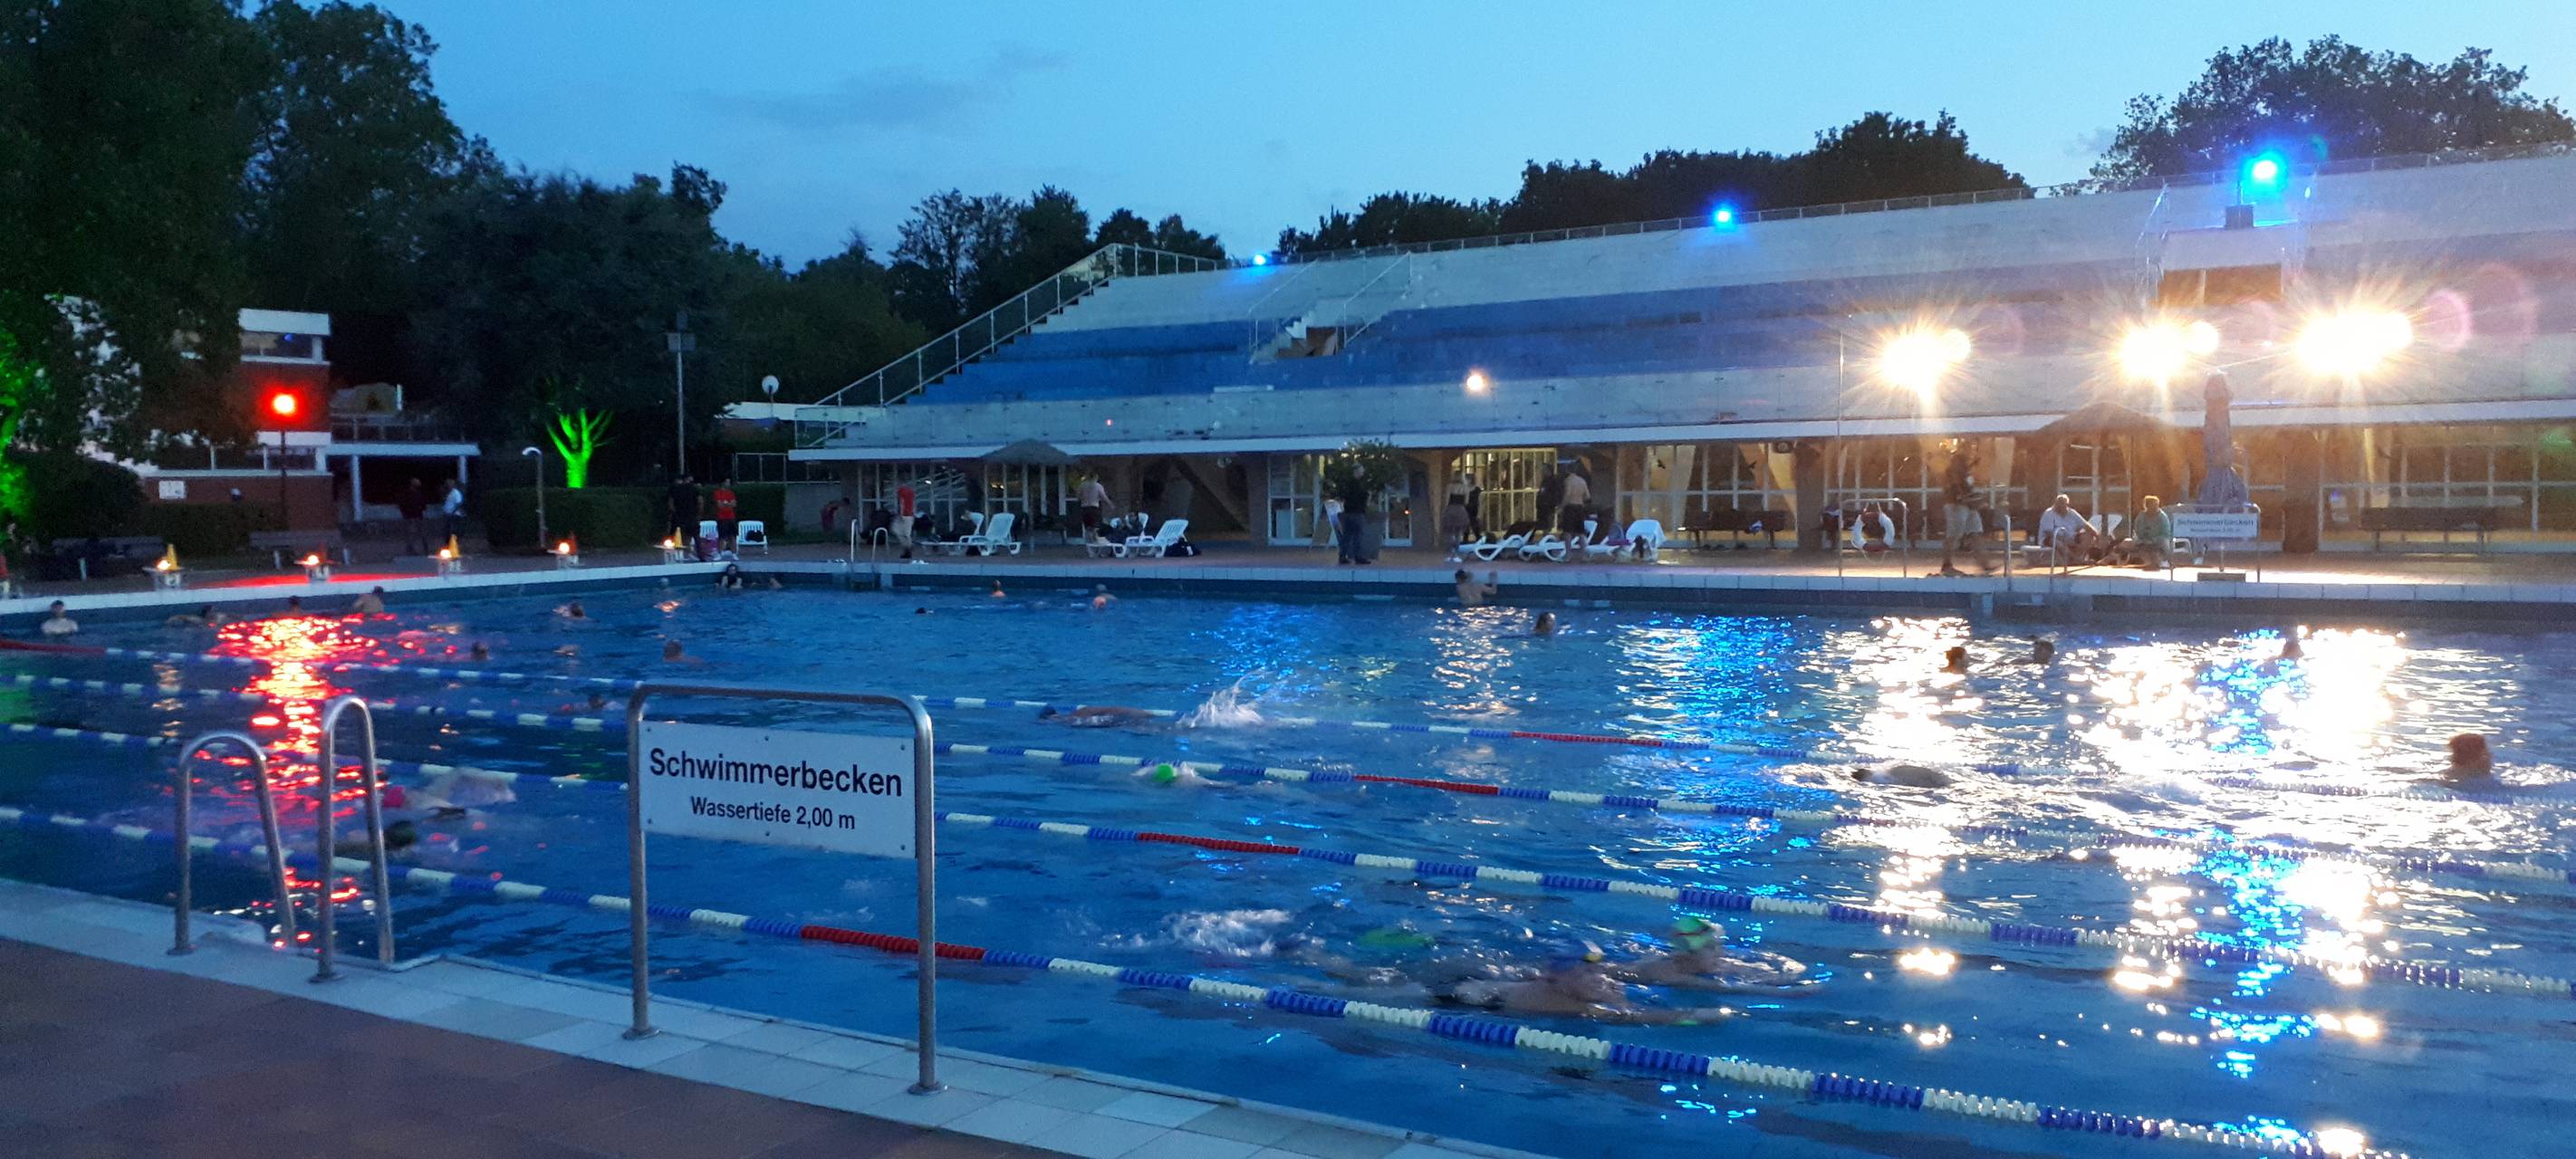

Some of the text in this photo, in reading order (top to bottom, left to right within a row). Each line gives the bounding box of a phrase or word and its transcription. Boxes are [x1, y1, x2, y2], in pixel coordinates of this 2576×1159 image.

[649, 747, 902, 797] Schwimmerbecken
[690, 796, 855, 829] Wassertiefe 2,00 m
